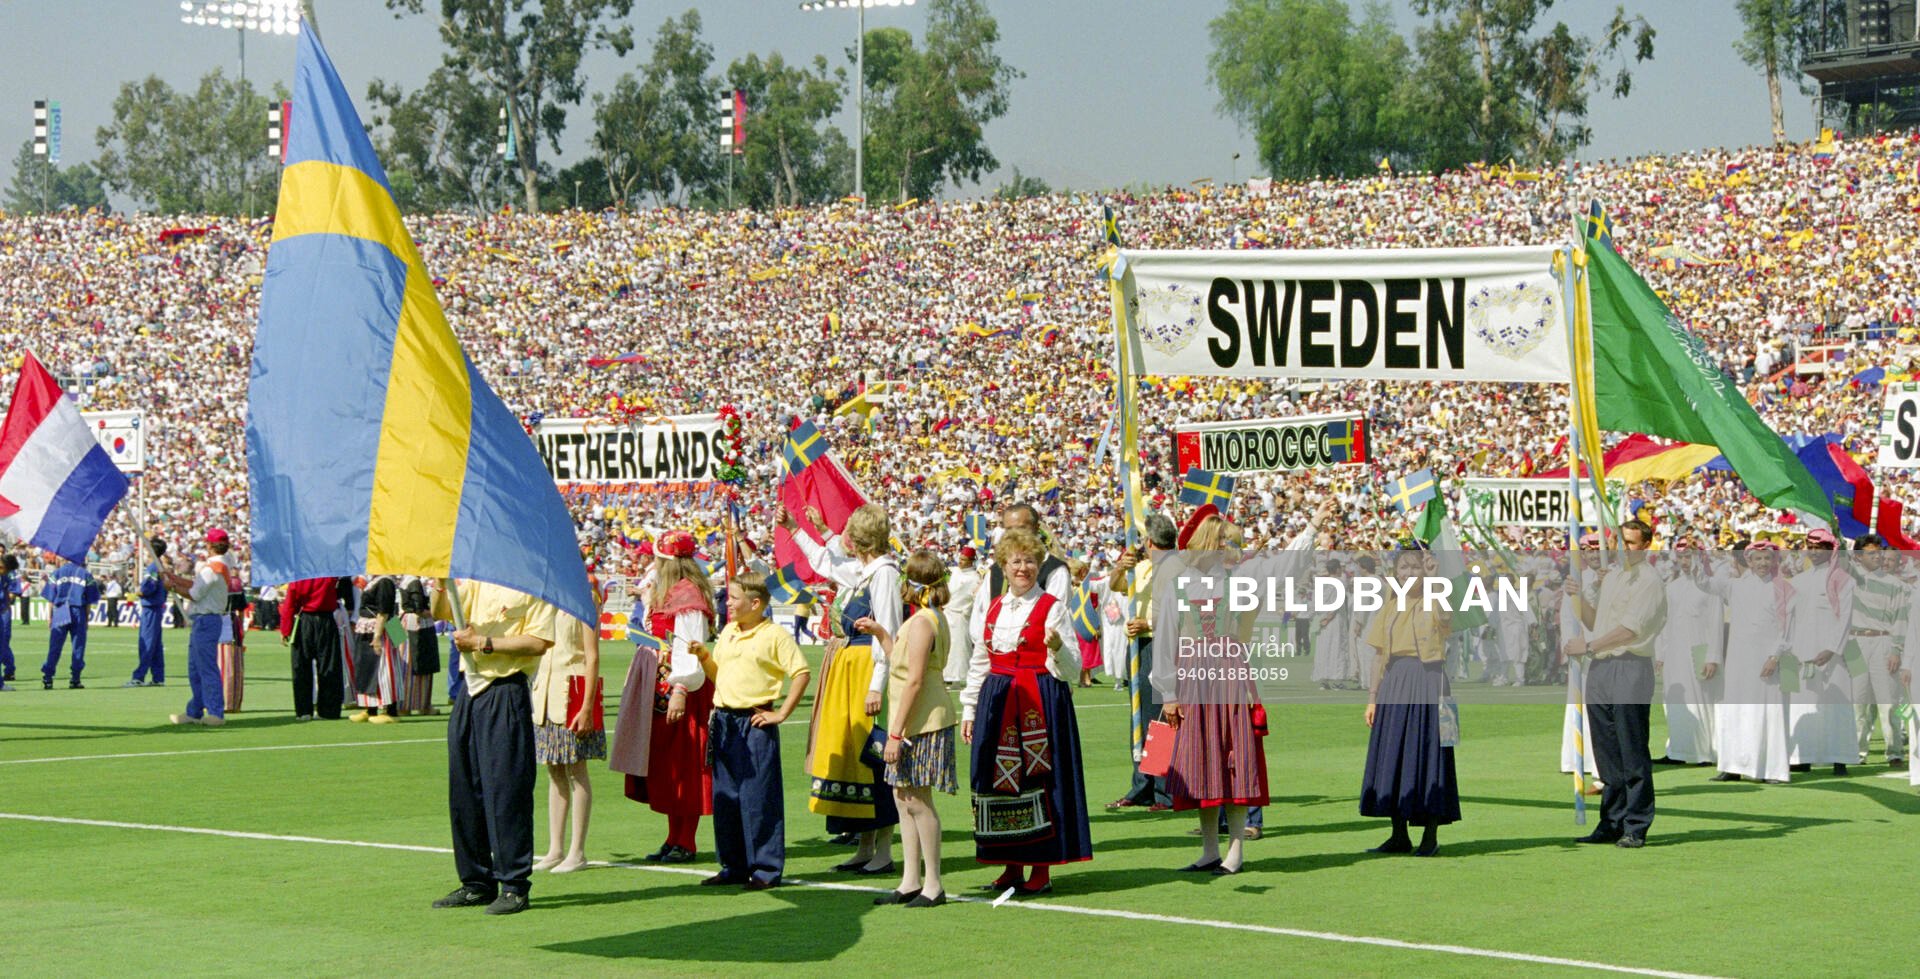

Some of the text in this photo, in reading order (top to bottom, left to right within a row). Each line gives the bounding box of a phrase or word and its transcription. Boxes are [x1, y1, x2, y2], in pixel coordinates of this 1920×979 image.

[1207, 276, 1465, 369] SWEDEN
[538, 429, 726, 479] NETHERLANDS
[1894, 399, 1920, 460] S
[1499, 488, 1583, 522] NIGERI
